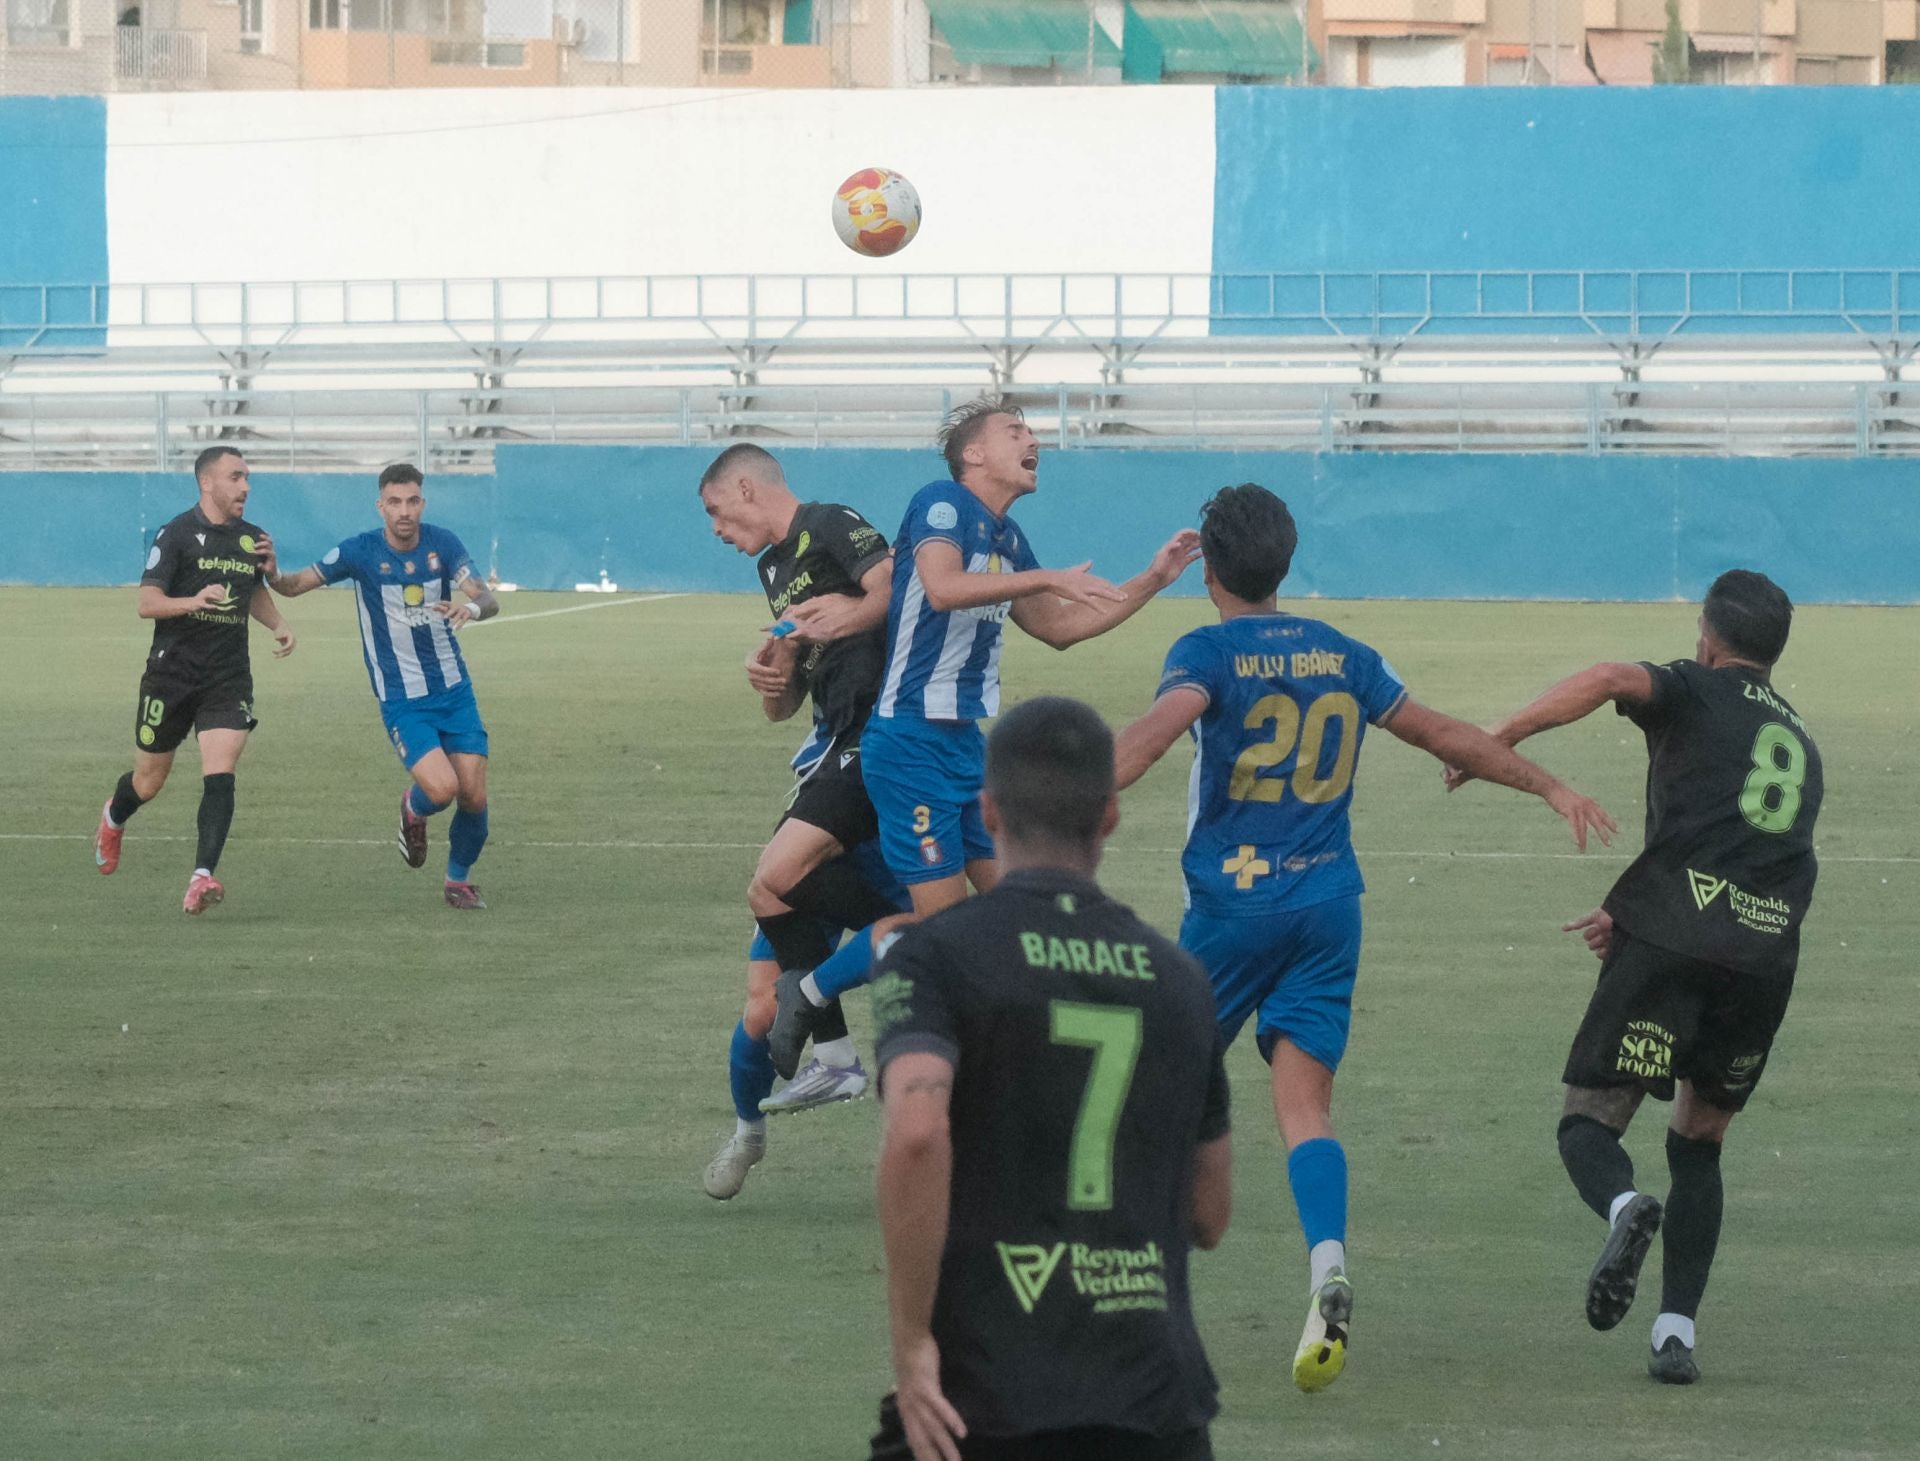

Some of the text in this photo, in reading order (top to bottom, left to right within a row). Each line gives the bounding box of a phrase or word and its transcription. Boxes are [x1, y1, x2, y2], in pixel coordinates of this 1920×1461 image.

[142, 695, 165, 727] 19
[1228, 691, 1359, 804] 20
[1738, 721, 1808, 834] 8
[912, 804, 930, 833] 3
[1728, 882, 1791, 914] Reynolds
[1729, 896, 1789, 926] Verdasco
[1019, 931, 1156, 981] BARACE
[1626, 1020, 1677, 1045] NORWAY
[1050, 1000, 1144, 1211] 7
[1071, 1241, 1166, 1273] Reynol
